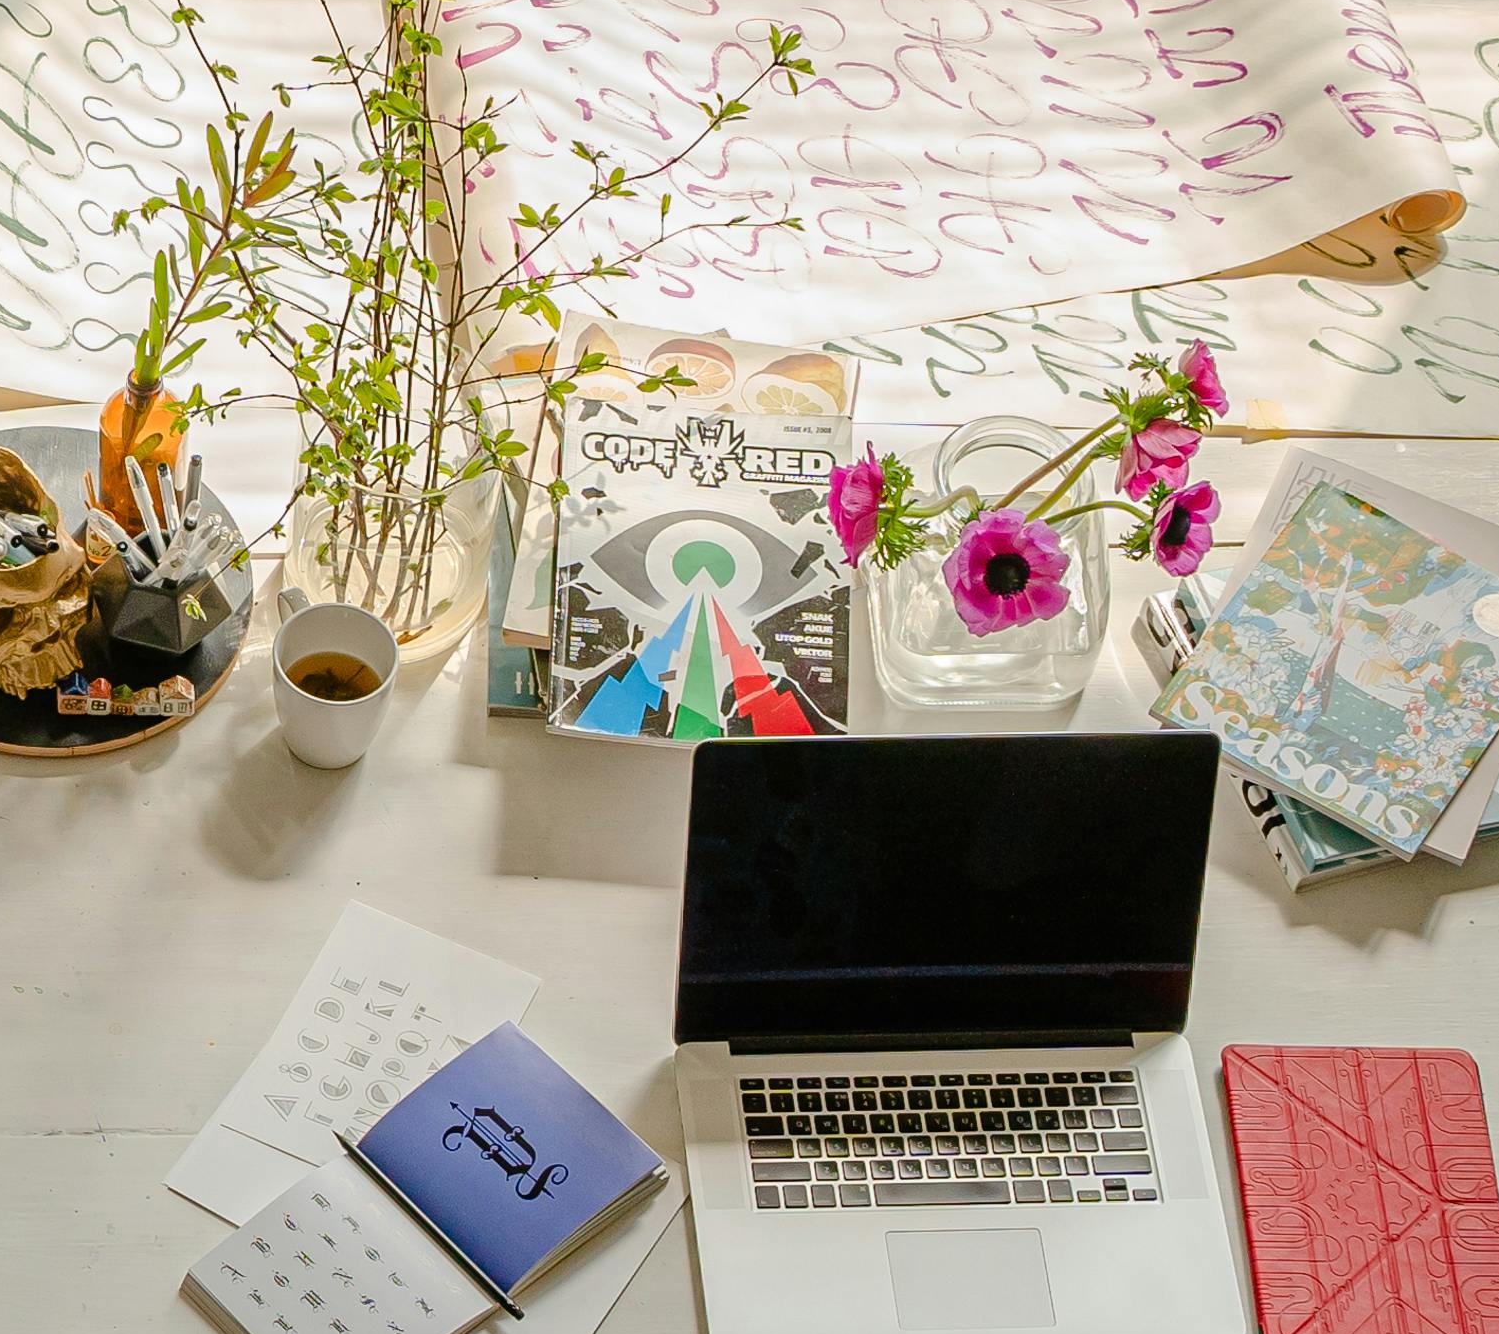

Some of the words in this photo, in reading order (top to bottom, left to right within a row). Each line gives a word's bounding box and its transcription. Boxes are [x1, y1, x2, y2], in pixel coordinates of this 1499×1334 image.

[581, 432, 678, 478] CODE
[741, 446, 836, 477] RED
[743, 472, 783, 482] GRAFFITI
[1173, 681, 1420, 838] Seasons
